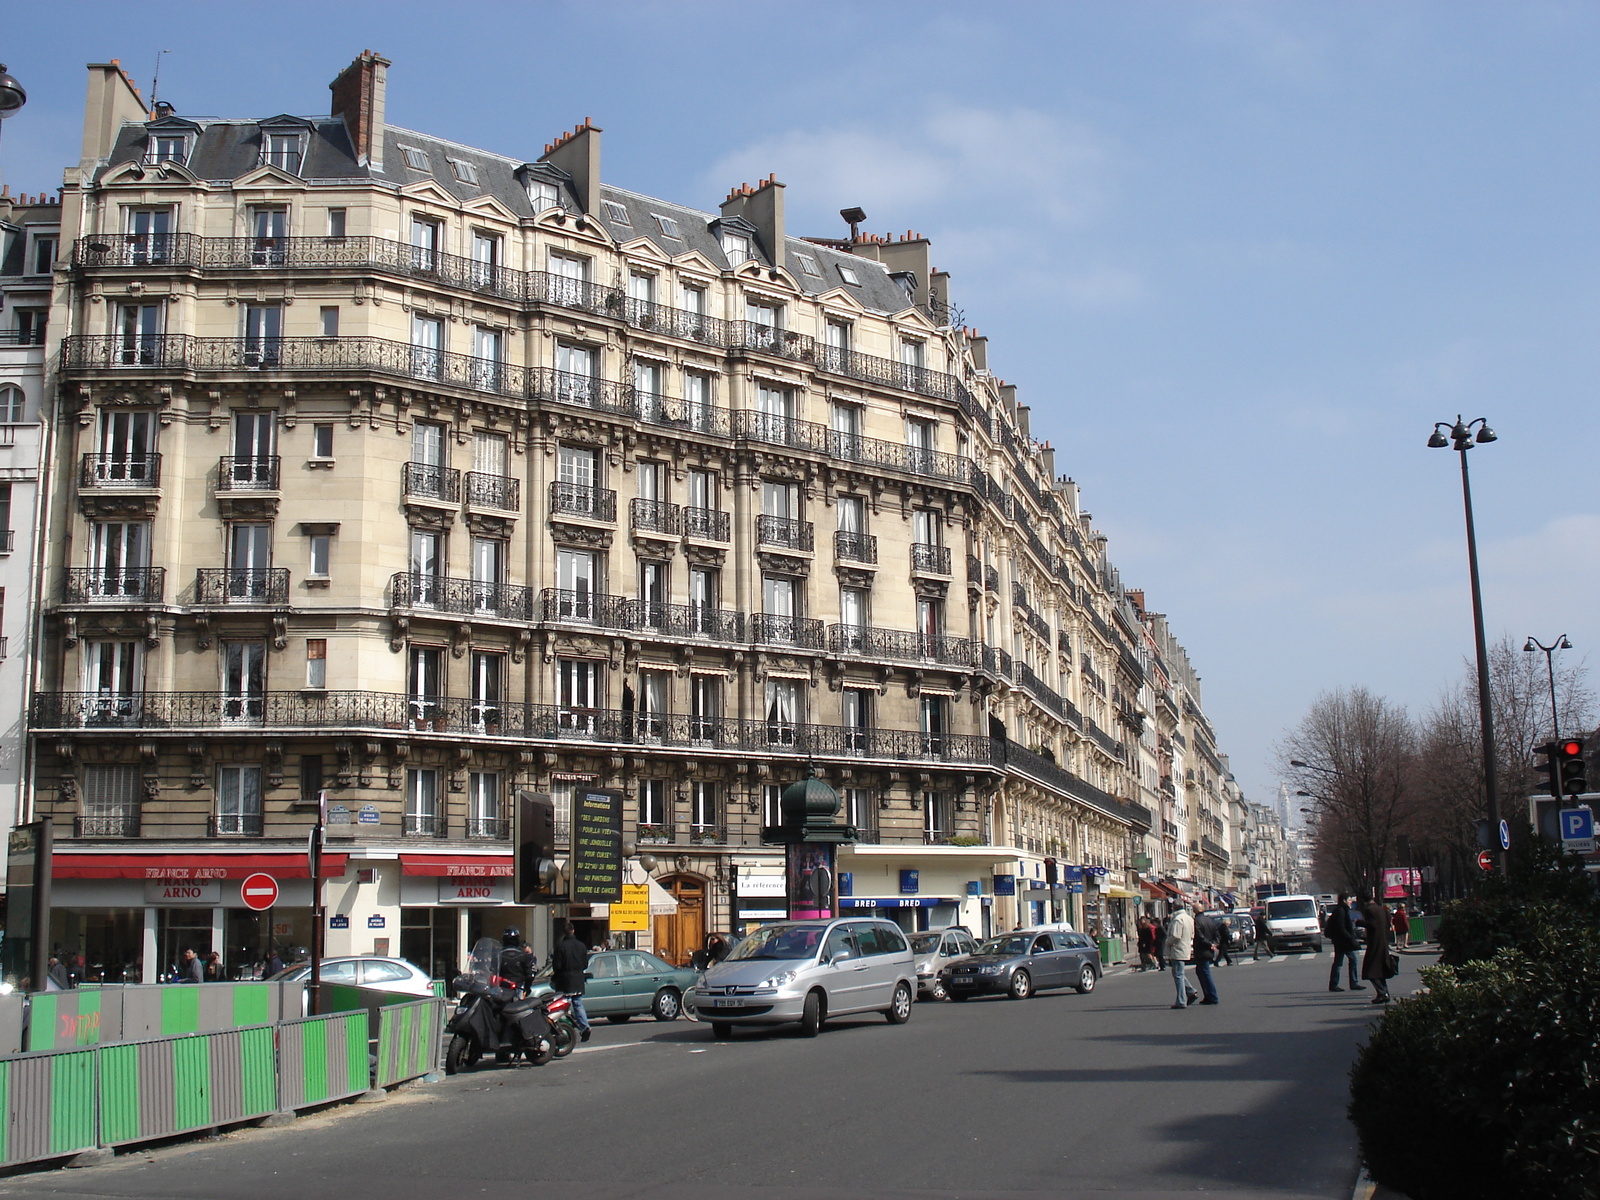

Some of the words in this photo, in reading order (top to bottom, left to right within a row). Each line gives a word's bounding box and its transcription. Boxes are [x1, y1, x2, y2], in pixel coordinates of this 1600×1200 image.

[1569, 815, 1584, 835] P
[580, 838, 589, 846] UNE
[584, 850, 596, 858] POUR
[145, 868, 189, 879] FRANCE
[194, 868, 228, 879] ARNO
[446, 865, 486, 876] FRANCE
[156, 877, 209, 887] FRANCE
[450, 876, 497, 887] FRANCE
[741, 881, 751, 889] La
[163, 887, 202, 898] ARNO
[457, 887, 491, 898] ARNO
[577, 886, 593, 894] CONTRE
[594, 886, 600, 894] LE
[601, 887, 617, 895] CANCER
[854, 899, 877, 908] BRED
[899, 899, 921, 907] BRED
